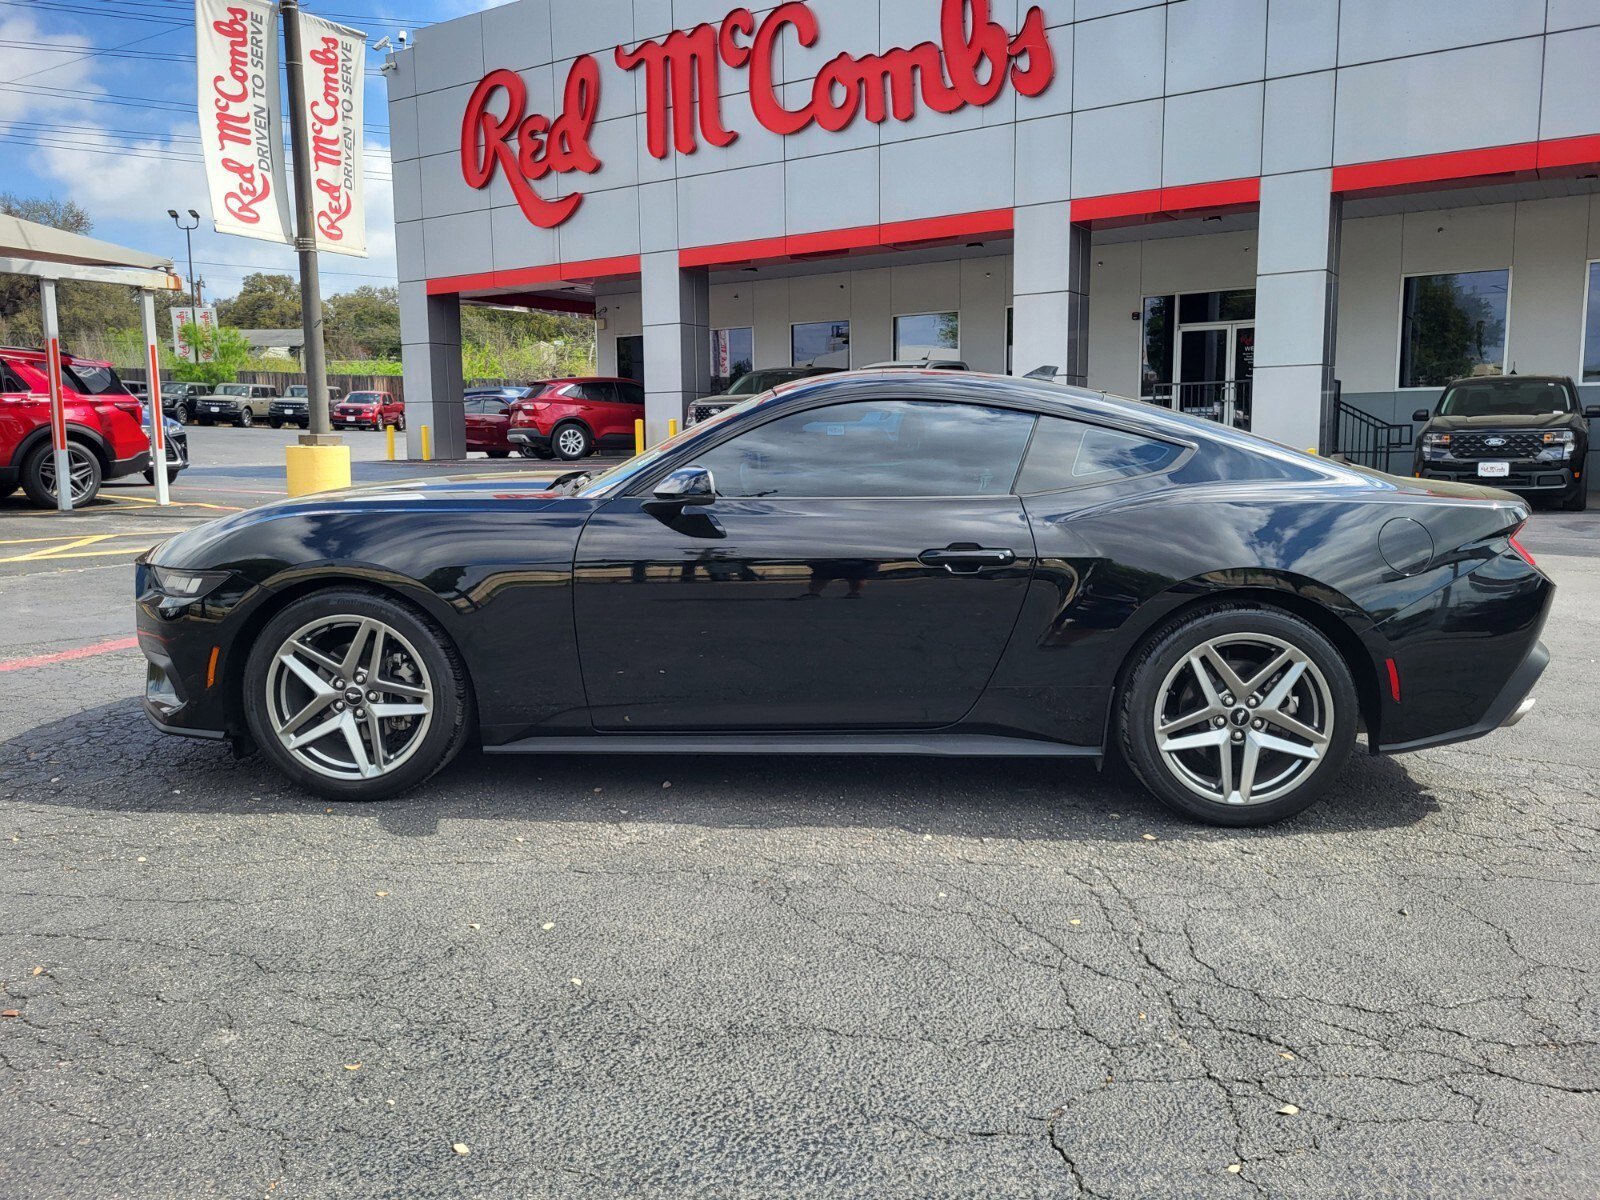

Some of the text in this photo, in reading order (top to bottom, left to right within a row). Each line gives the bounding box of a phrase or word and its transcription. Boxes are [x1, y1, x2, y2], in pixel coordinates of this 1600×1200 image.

[213, 6, 270, 224] Red McCombs
[250, 11, 271, 173] DRIVEN TO SERVE
[309, 36, 352, 241] Red McCombs
[340, 40, 354, 191] DRIVEN TO SERVE
[461, 0, 1055, 229] Red McCombs
